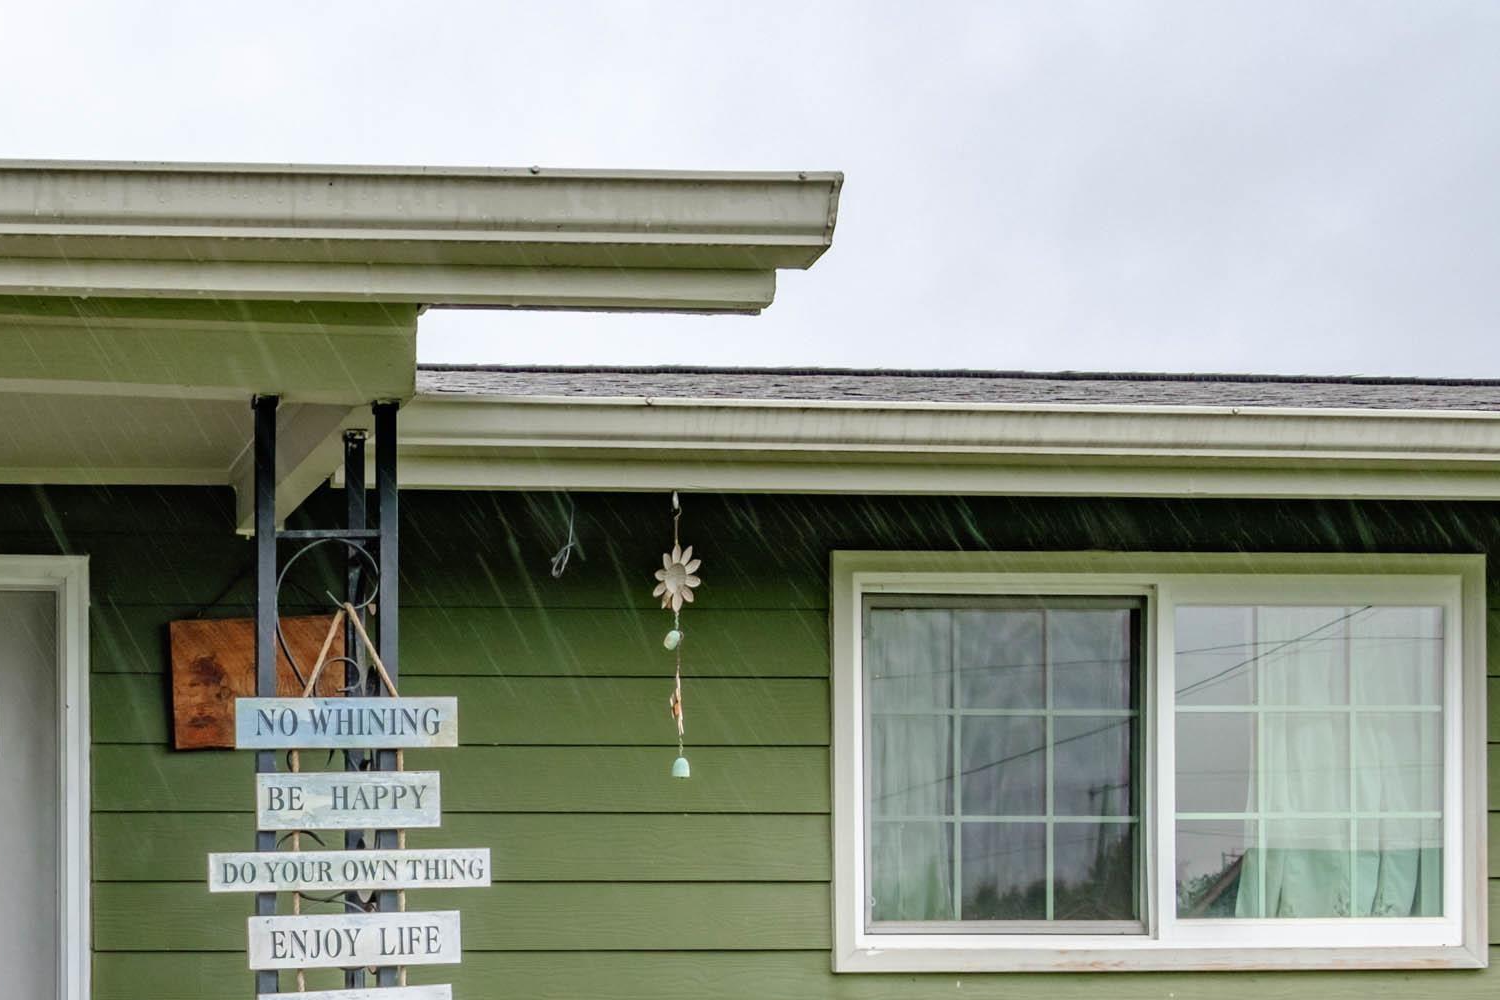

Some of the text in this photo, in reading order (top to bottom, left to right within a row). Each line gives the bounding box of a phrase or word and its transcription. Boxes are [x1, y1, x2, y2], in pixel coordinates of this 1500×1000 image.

[256, 707, 441, 737] NO WHINING
[267, 784, 428, 812] BE HAPPY
[222, 858, 484, 884] DO YOUR OWN THING
[270, 925, 442, 960] ENJOY LIFE
